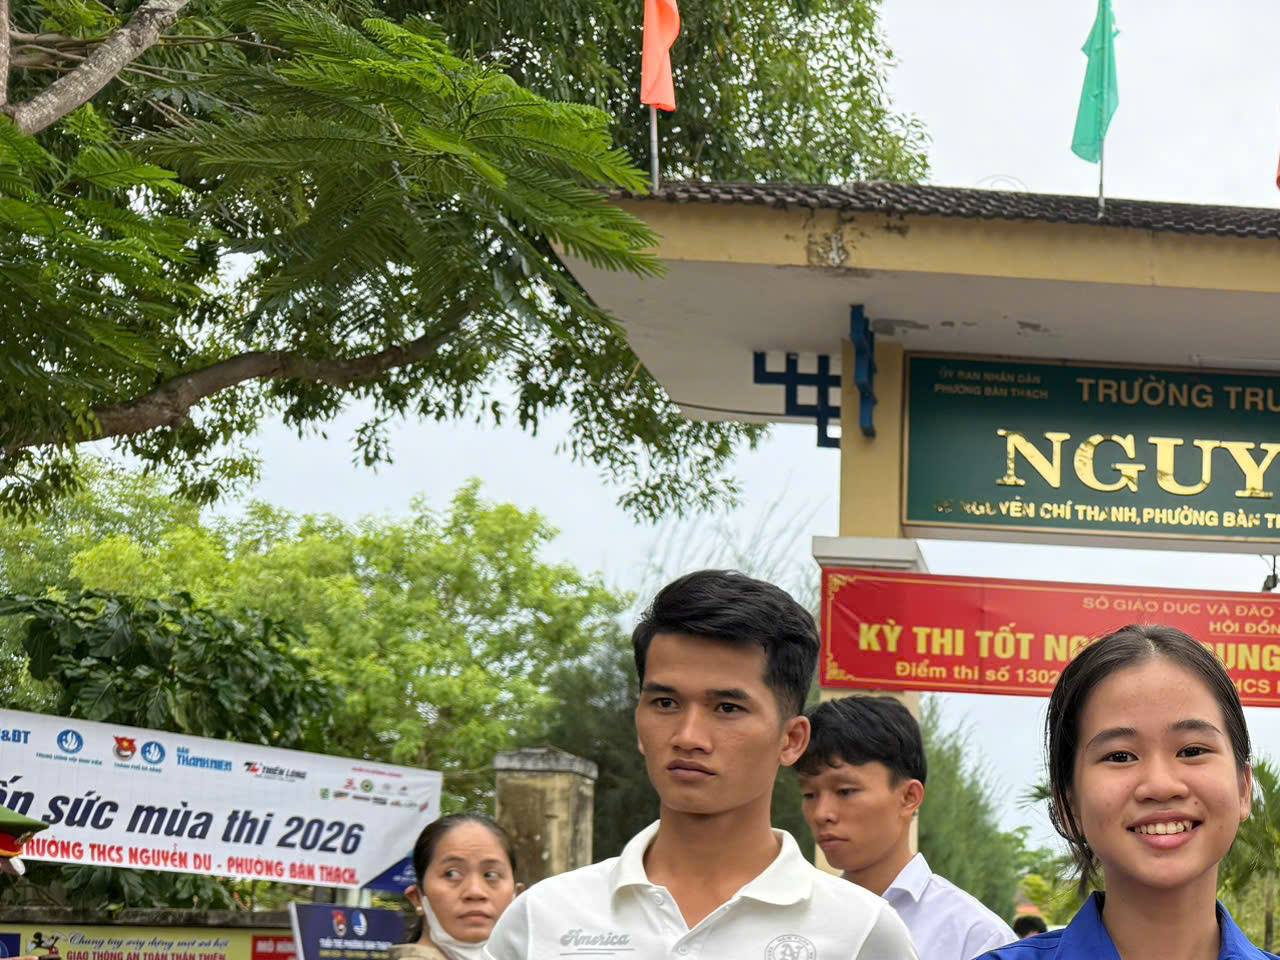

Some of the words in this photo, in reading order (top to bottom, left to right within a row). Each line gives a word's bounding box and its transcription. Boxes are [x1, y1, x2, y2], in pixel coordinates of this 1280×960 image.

[1076, 375, 1213, 407] TRƯỜNG
[1040, 500, 1072, 520] CHÍ
[1143, 506, 1218, 526] PHƯỜNG
[1113, 597, 1159, 611] GIÁO
[1163, 600, 1200, 616] DỤC
[1206, 603, 1231, 616] VÀ
[1235, 603, 1275, 618] ĐÀO
[859, 619, 903, 652] KỲ
[912, 626, 965, 656] THI
[975, 622, 1034, 660] TỐT
[1209, 620, 1240, 635] HỘI
[895, 659, 947, 679] Điểm
[953, 664, 979, 681] thi
[985, 665, 1010, 682] số
[42, 790, 119, 830] sức
[126, 801, 213, 840] mùa
[222, 809, 275, 846] thi
[276, 816, 365, 855] 2026
[89, 843, 124, 863] THCS
[194, 853, 212, 871] DU
[560, 929, 631, 947] America
